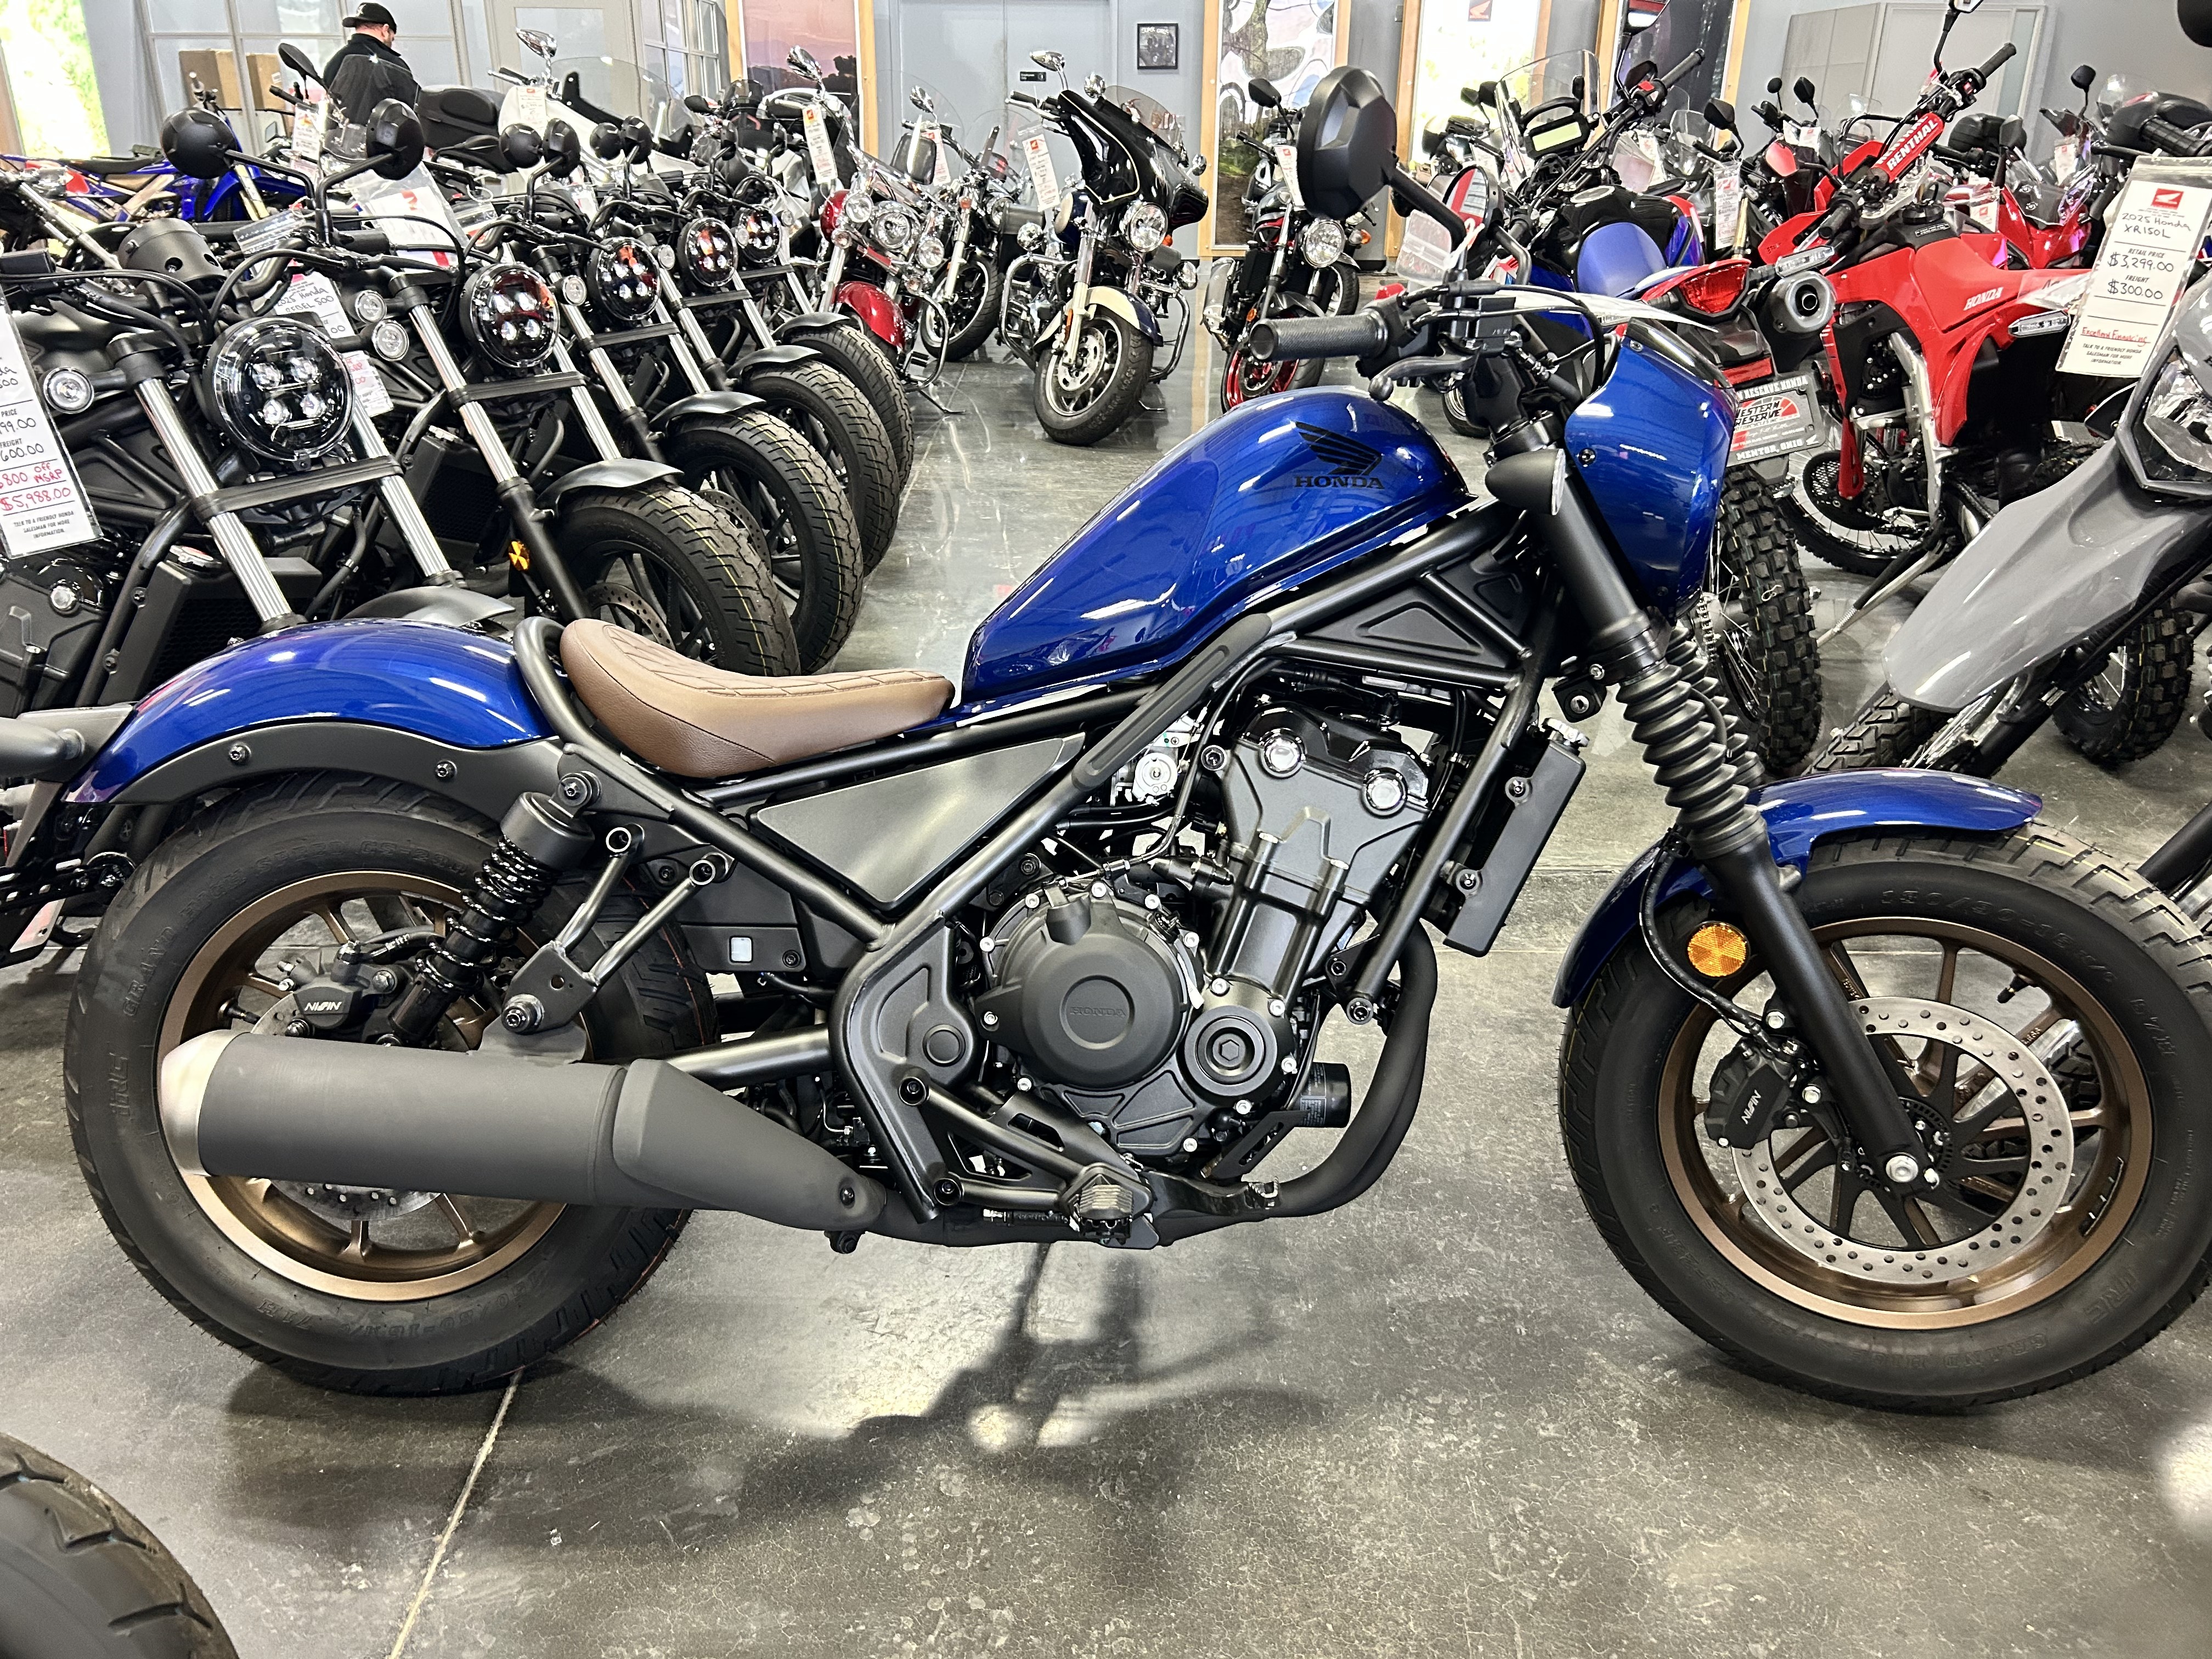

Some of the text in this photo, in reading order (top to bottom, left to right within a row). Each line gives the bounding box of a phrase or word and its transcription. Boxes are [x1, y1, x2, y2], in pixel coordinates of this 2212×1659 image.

[1887, 120, 1938, 171] RENTHAL
[2122, 213, 2151, 223] 2025
[2154, 217, 2191, 231] Honda
[2128, 248, 2147, 256] RETAIL
[2125, 275, 2150, 283] FREIGHT
[2107, 279, 2163, 300] $300.00
[278, 295, 296, 307] 2025
[299, 286, 329, 299] Honda
[314, 296, 334, 306] 500
[1963, 287, 2004, 311] HONDA
[1744, 382, 1779, 399] RESERVE
[1780, 376, 1808, 391] HONDA
[1, 409, 17, 417] PRICE
[0, 438, 22, 448] FREIGHT
[1780, 439, 1803, 451] OHIO
[34, 462, 50, 472] OFF
[34, 469, 62, 483] MSRP
[1294, 476, 1385, 489] HONDA
[0, 487, 71, 511] $5,988.00
[36, 515, 57, 523] FRIENDLY
[1070, 1006, 1126, 1017] HONDA
